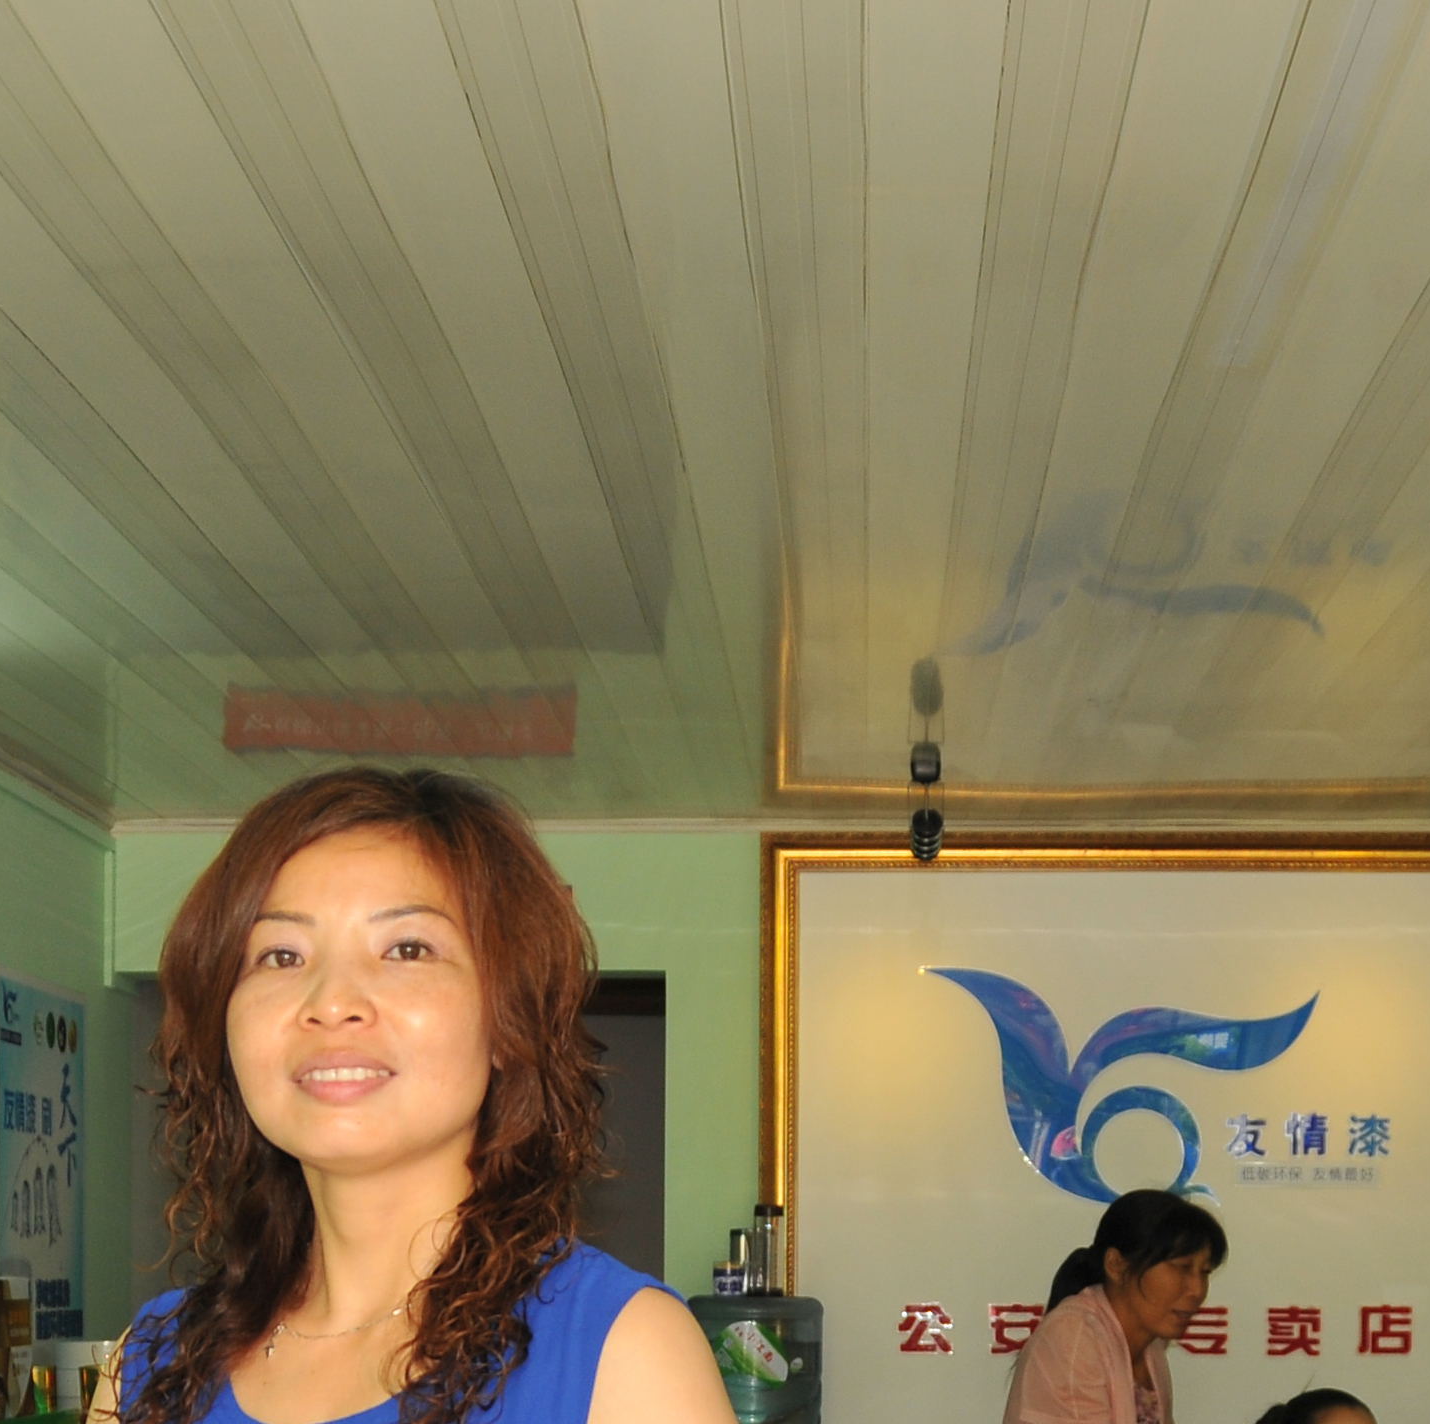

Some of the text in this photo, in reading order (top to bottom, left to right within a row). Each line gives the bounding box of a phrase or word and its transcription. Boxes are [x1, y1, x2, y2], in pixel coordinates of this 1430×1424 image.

[1225, 1112, 1392, 1160] 友情漆
[1240, 1165, 1375, 1183] 低碳环保 友情最好
[898, 1301, 1413, 1358] 公安专卖店
